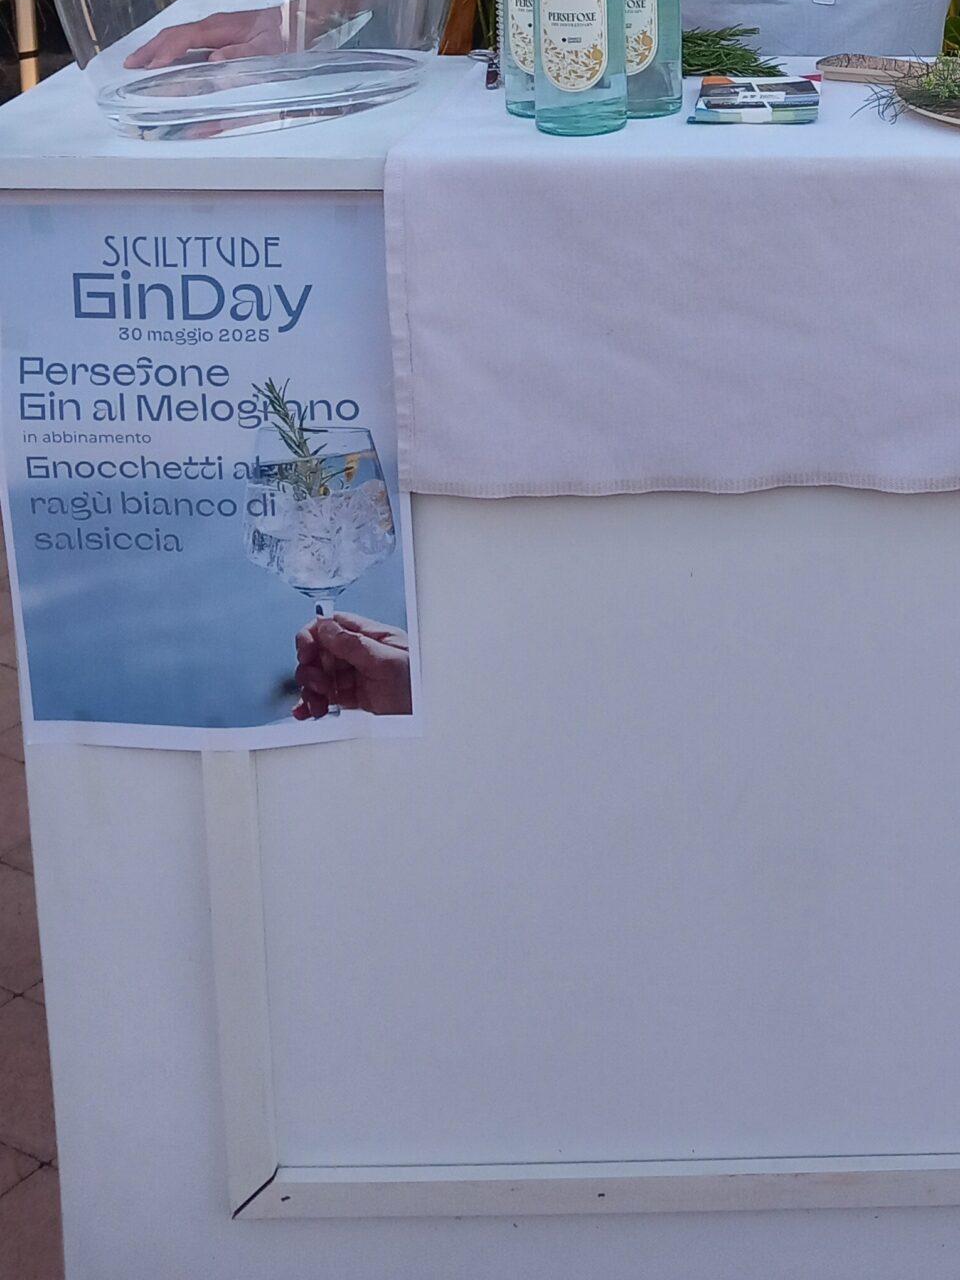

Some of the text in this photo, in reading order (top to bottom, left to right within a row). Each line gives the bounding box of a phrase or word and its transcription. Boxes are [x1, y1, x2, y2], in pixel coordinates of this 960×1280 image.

[102, 235, 283, 268] SICILYTUDE
[73, 270, 313, 333] GinDay
[118, 327, 271, 346] 30 maggio 2025
[19, 356, 230, 387] Persefone
[19, 391, 81, 421] Gin
[92, 392, 126, 422] al
[22, 430, 153, 445] in abbinamento
[26, 456, 223, 480] Gnocchetti
[30, 491, 277, 521] ragù bianco di
[33, 526, 185, 553] salsiccia
